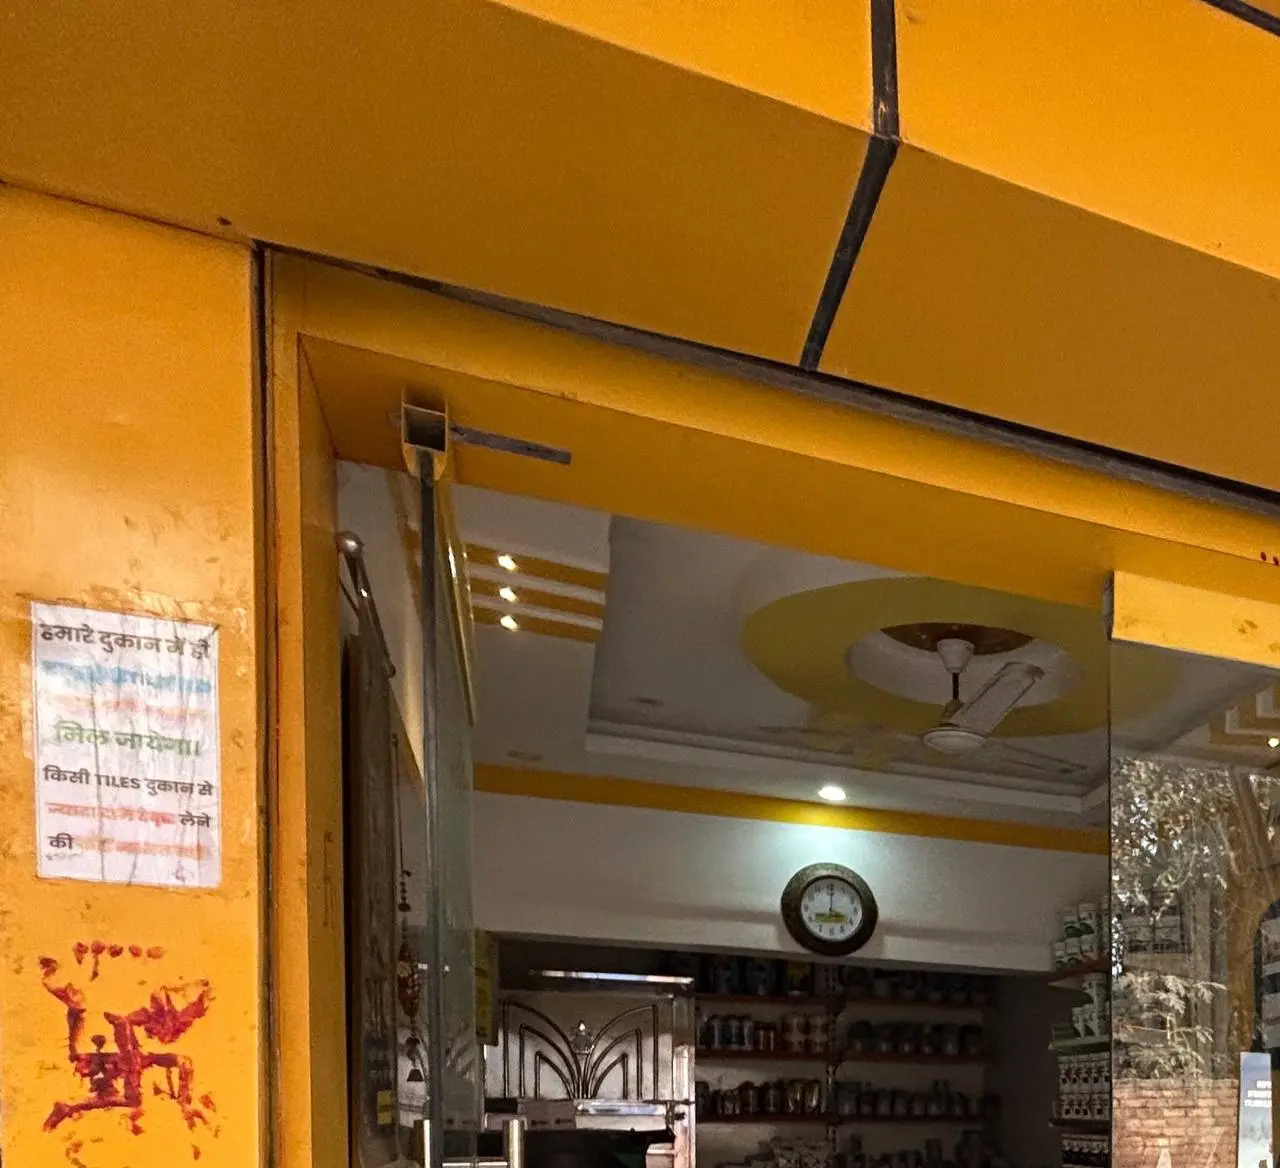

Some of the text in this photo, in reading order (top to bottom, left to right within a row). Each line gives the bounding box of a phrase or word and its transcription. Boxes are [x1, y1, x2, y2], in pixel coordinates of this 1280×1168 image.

[40, 624, 95, 642] हमारे
[97, 629, 161, 653] दुकान
[43, 764, 90, 785] किसी
[145, 777, 194, 796] दुकान
[197, 779, 213, 797] से
